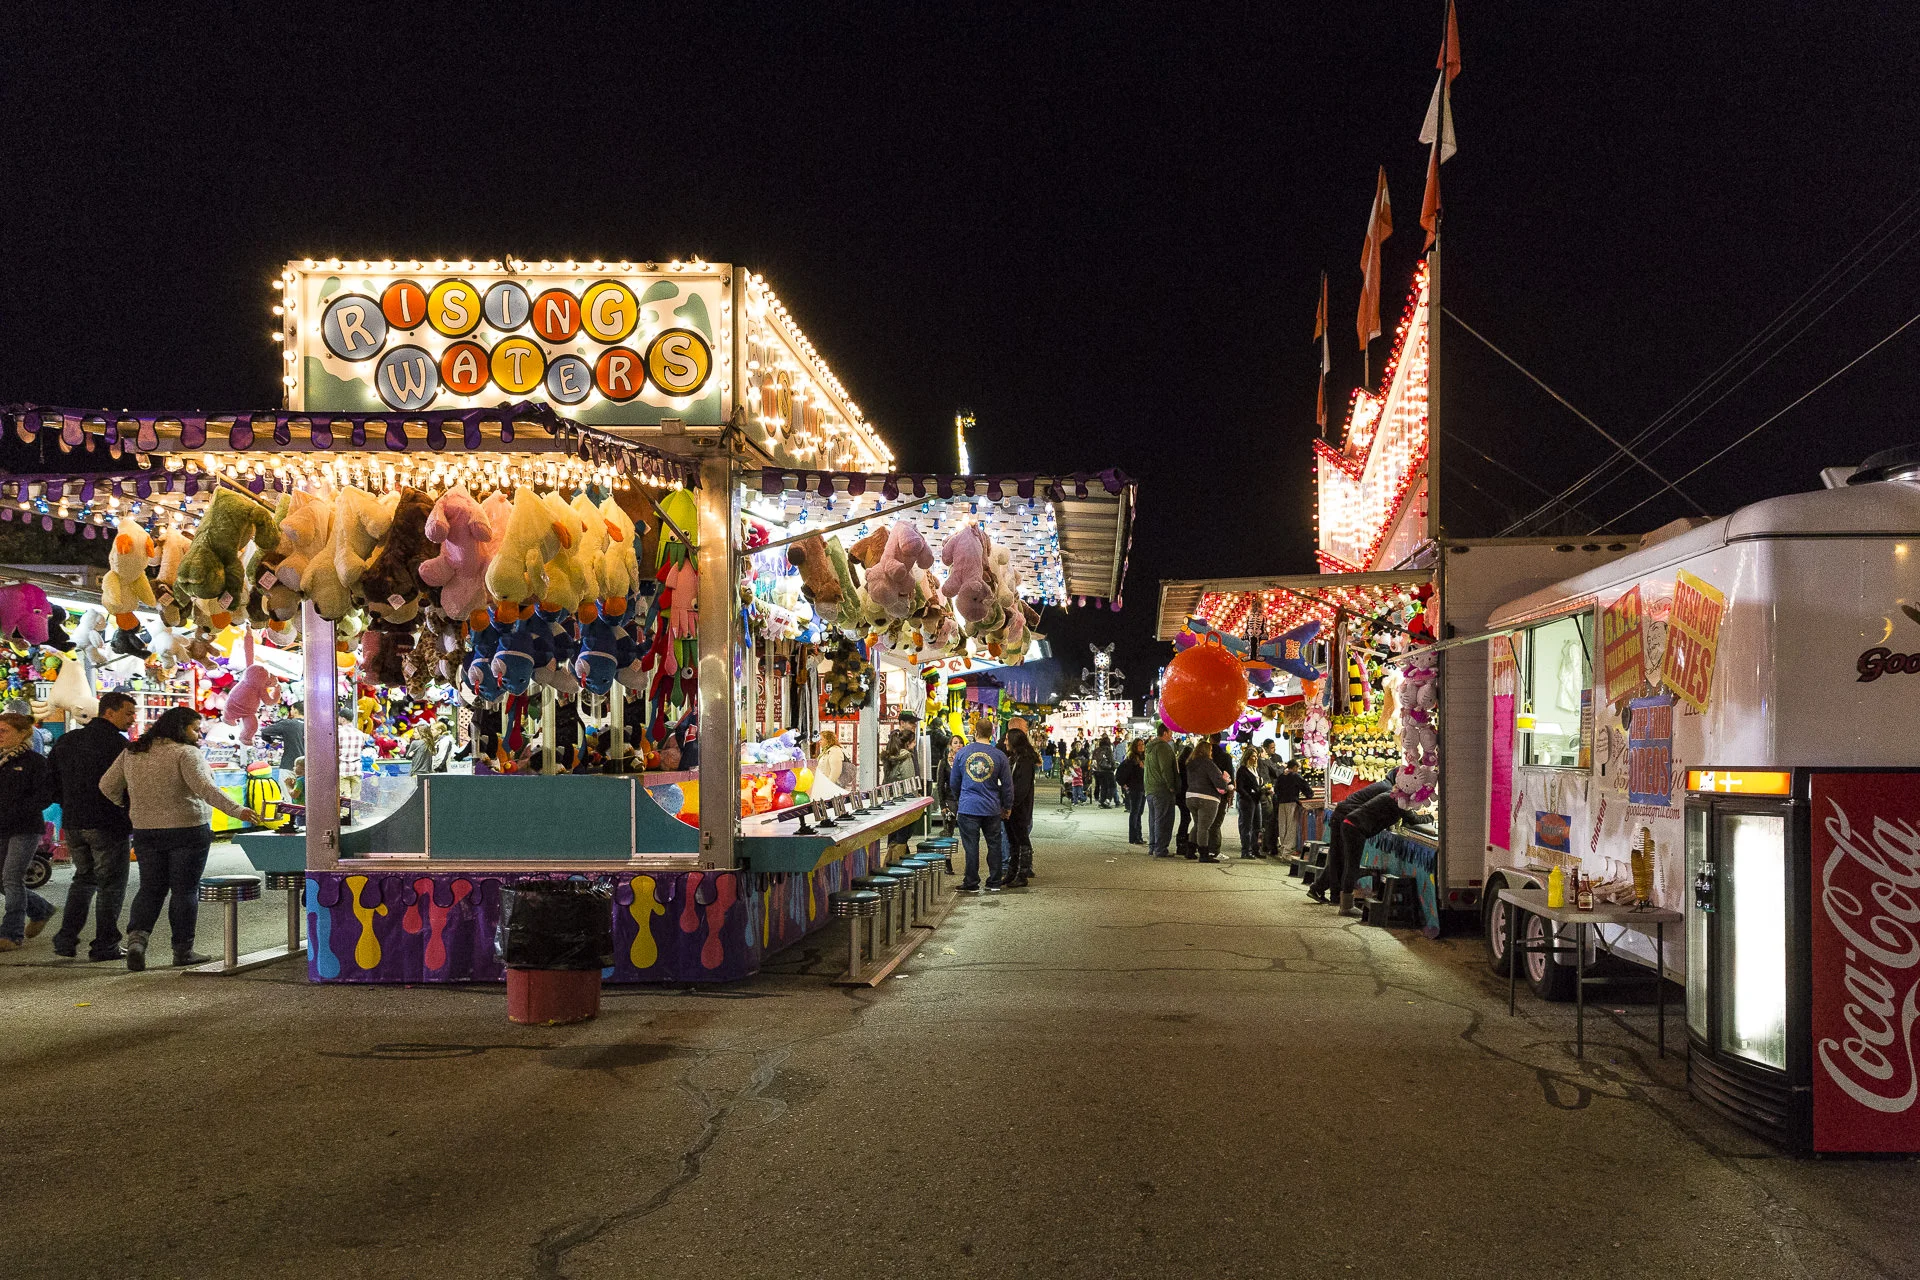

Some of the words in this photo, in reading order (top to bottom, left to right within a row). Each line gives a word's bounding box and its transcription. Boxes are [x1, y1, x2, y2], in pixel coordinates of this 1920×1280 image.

[333, 287, 624, 352] RISING
[387, 336, 699, 404] WATERS
[1674, 579, 1702, 632] FRESH
[1699, 596, 1722, 643] CUT
[1663, 624, 1713, 705] FRIES
[1631, 707, 1648, 740] DEEP
[1649, 705, 1672, 740] FRIED
[1630, 746, 1670, 796] OREOS
[1818, 796, 1920, 1113] Coca-Cola
